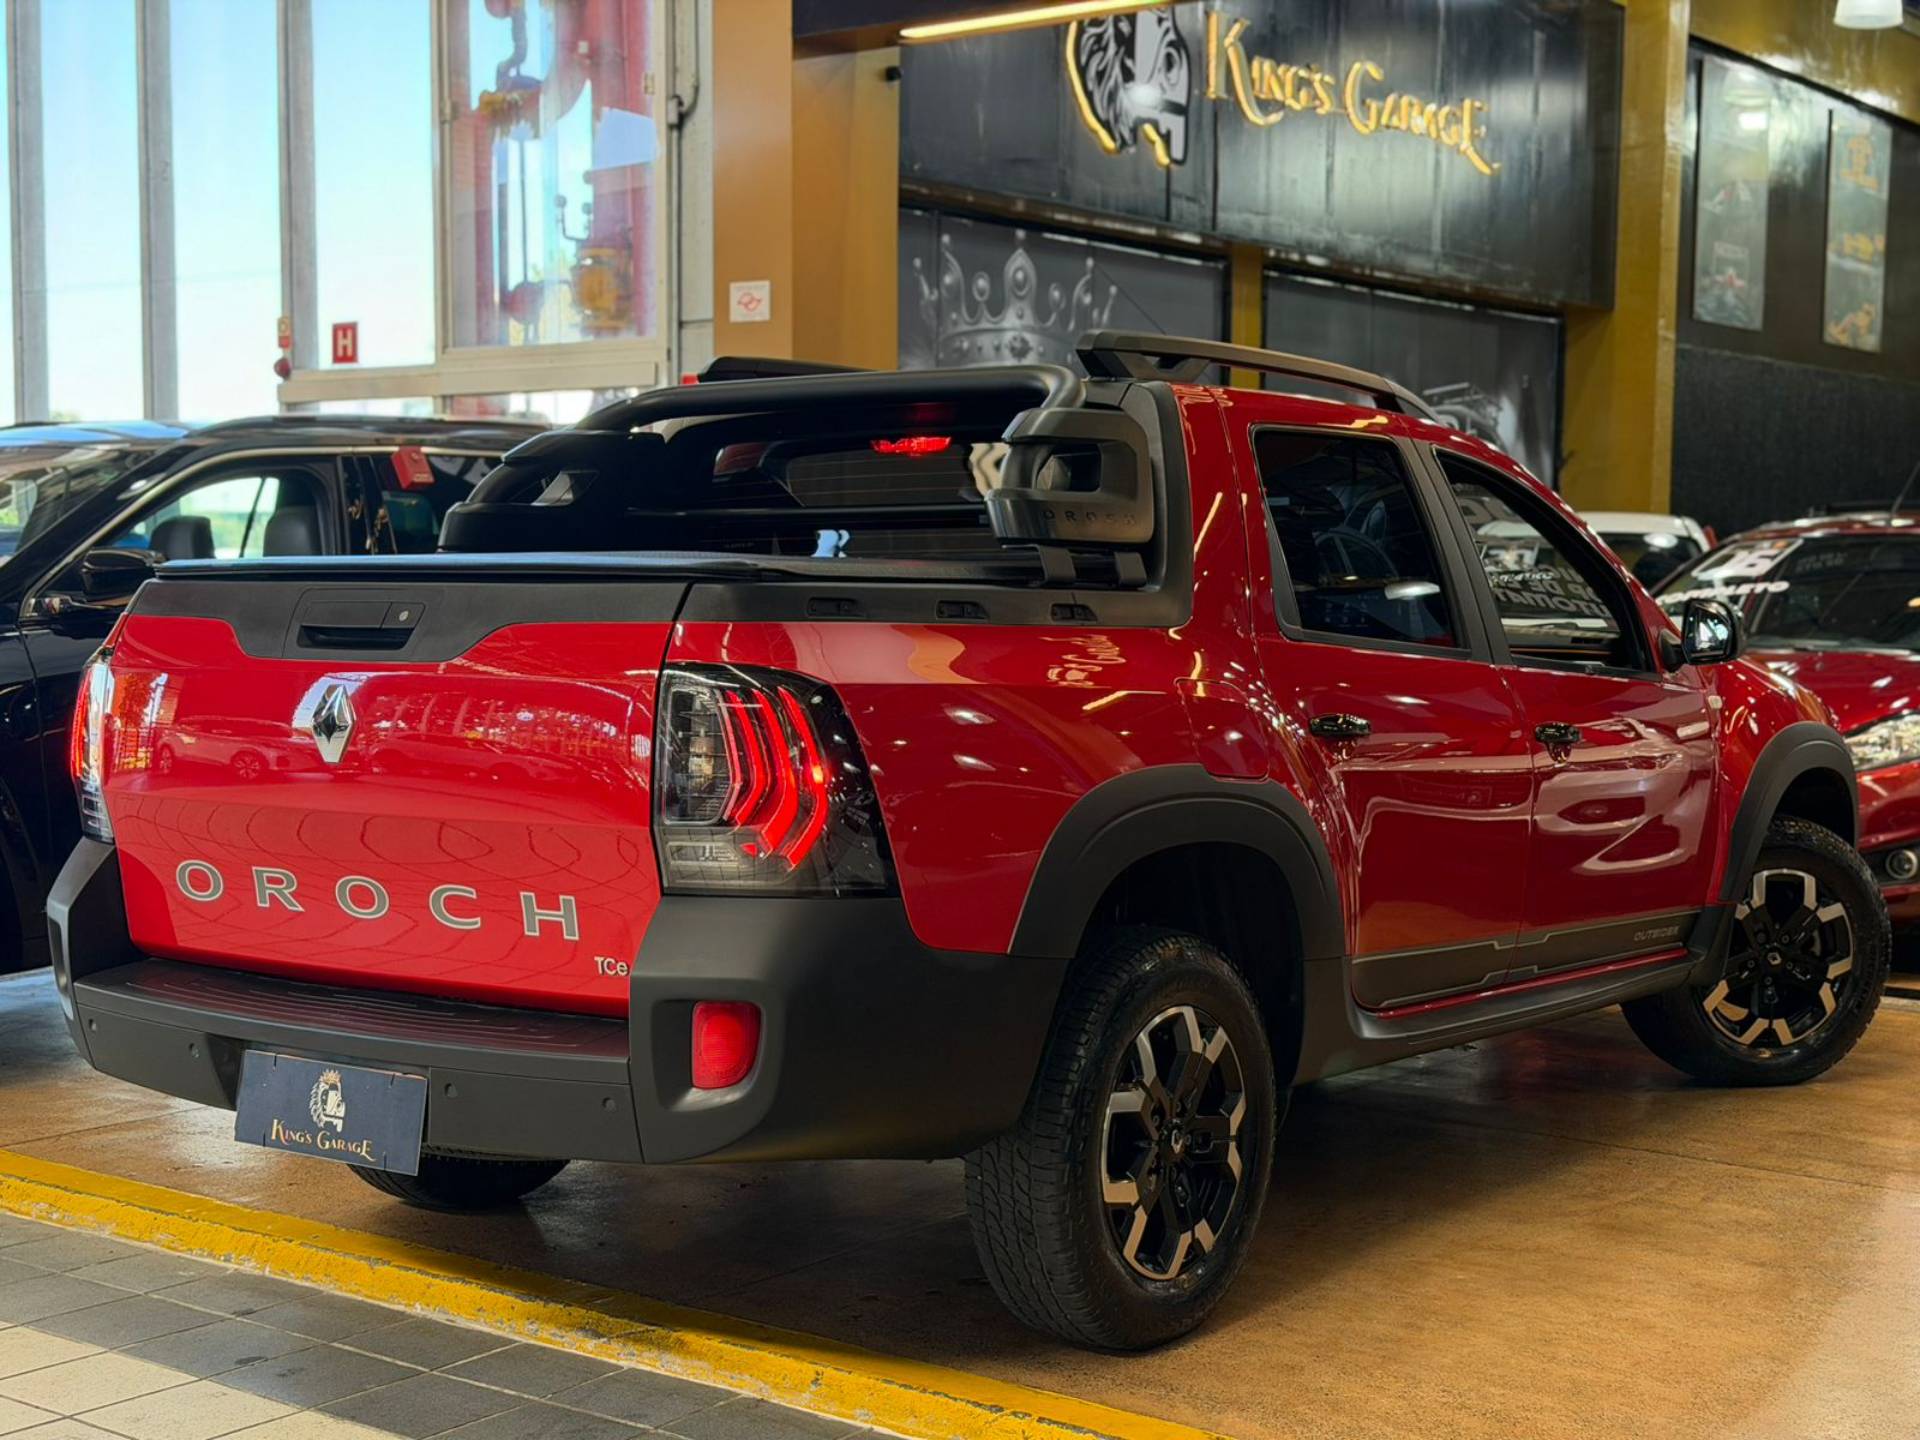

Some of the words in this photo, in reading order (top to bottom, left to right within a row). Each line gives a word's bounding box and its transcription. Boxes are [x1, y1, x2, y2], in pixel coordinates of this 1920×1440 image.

[336, 328, 353, 357] H
[175, 859, 580, 940] OROCH
[594, 956, 629, 976] TCe
[271, 1118, 312, 1145] KING'S
[317, 1130, 376, 1162] GARAGE
